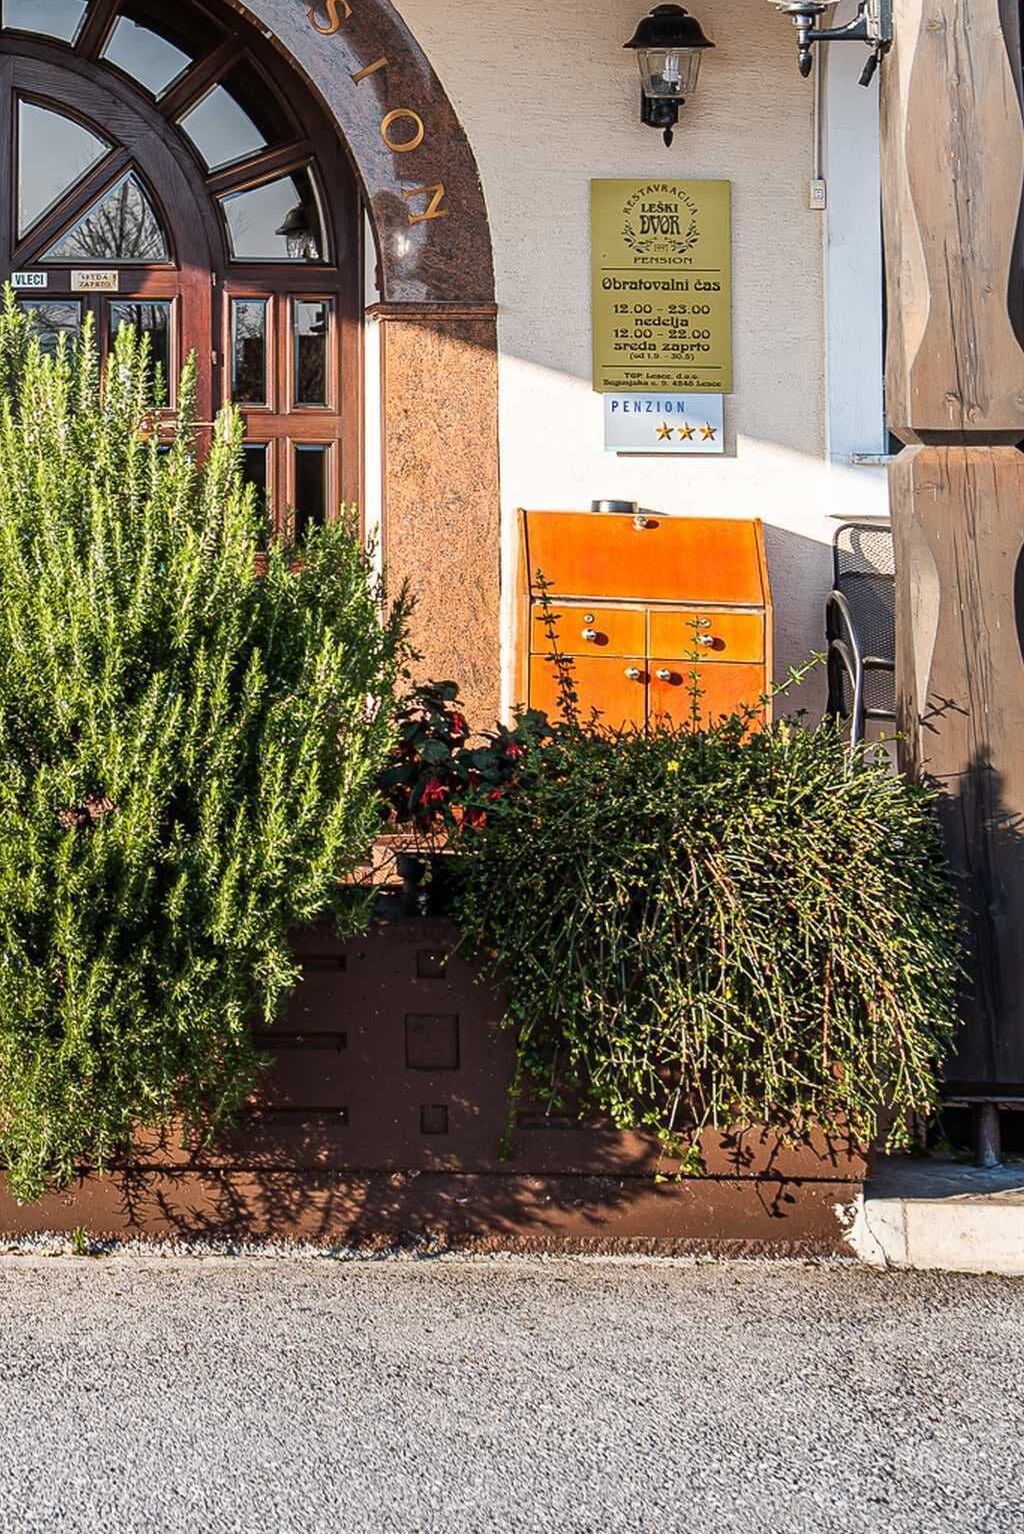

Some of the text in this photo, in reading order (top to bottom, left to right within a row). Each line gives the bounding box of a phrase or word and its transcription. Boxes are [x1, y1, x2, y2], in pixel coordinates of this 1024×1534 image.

[622, 183, 699, 215] RESTAVRACIJA
[641, 201, 679, 213] LEŠKI
[639, 215, 681, 235] DVOR
[633, 256, 693, 264] PENSION
[15, 274, 44, 285] VLECI
[602, 277, 721, 291] Obratovalni čas
[613, 304, 653, 314] 12.00
[668, 304, 711, 314] 23.00
[634, 316, 689, 328] nedelja
[613, 329, 653, 339] 12.00
[668, 329, 711, 339] 22.00
[614, 341, 711, 353] sreda zaprto
[612, 401, 685, 412] PENZION
